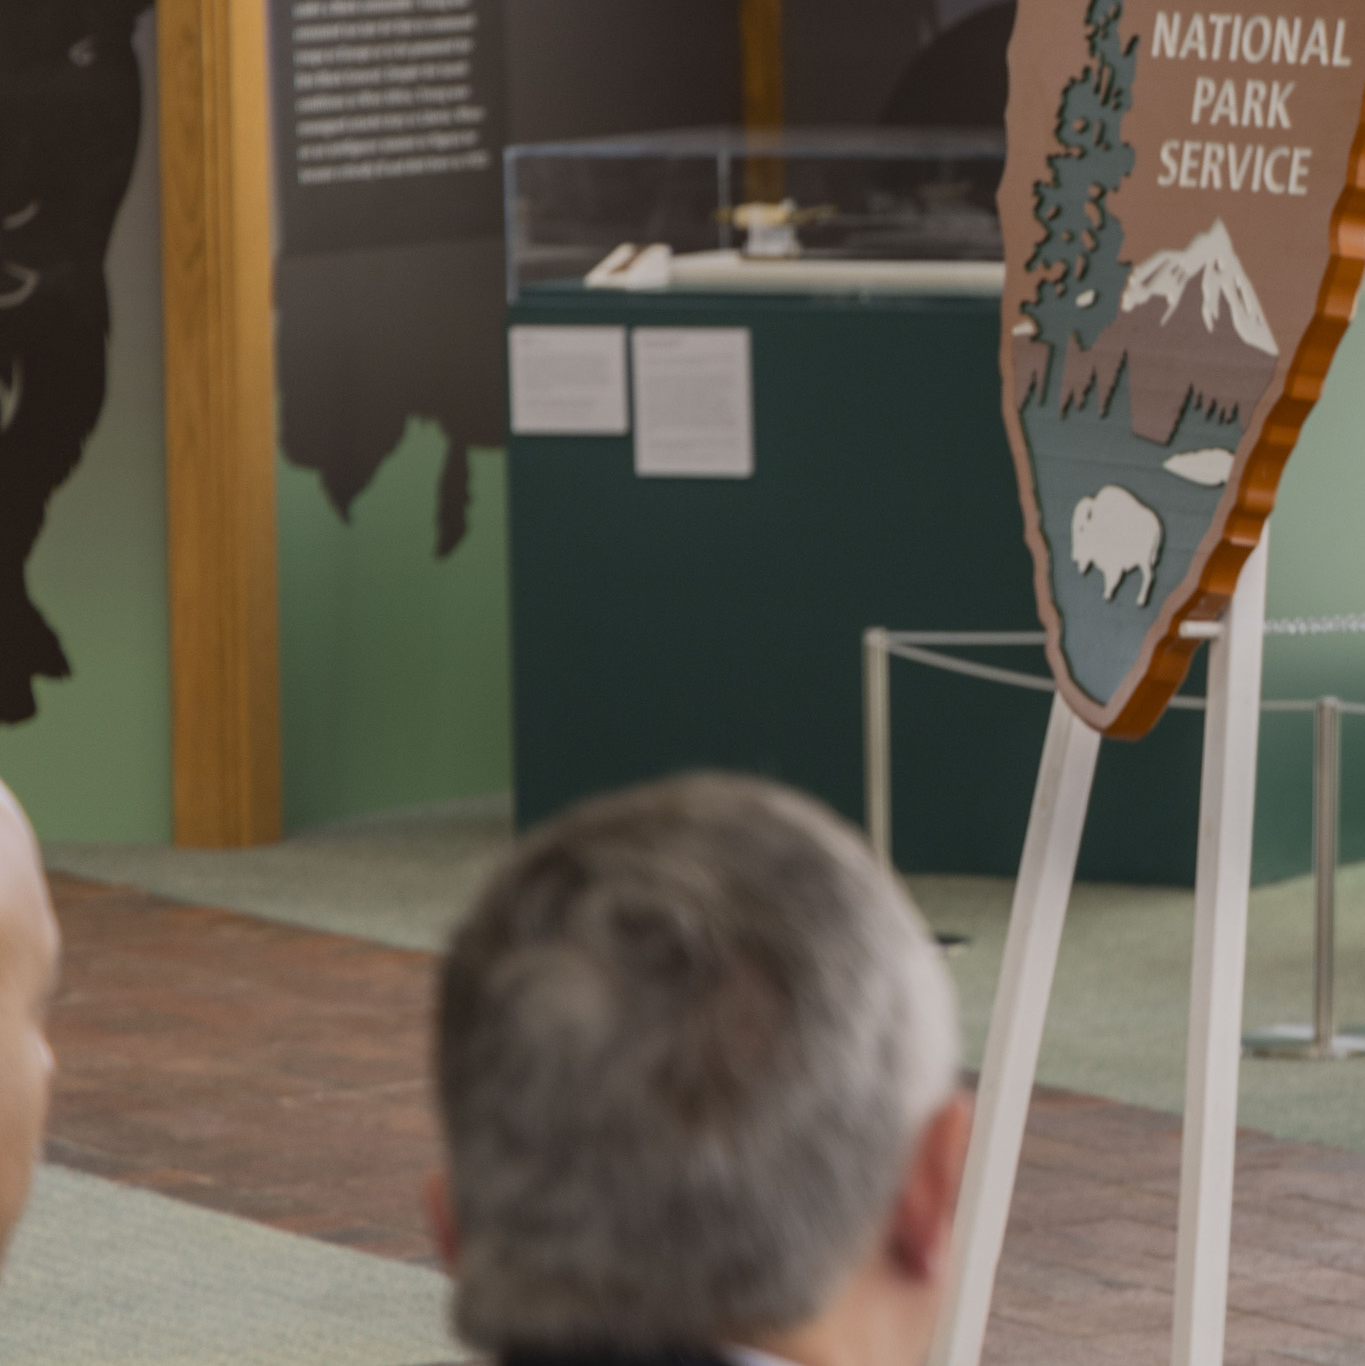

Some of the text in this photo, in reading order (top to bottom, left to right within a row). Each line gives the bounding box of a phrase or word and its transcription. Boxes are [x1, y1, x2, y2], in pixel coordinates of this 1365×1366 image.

[1151, 10, 1351, 67] NATIONAL
[1191, 76, 1296, 130] PARK
[1157, 139, 1312, 196] SERVICE
